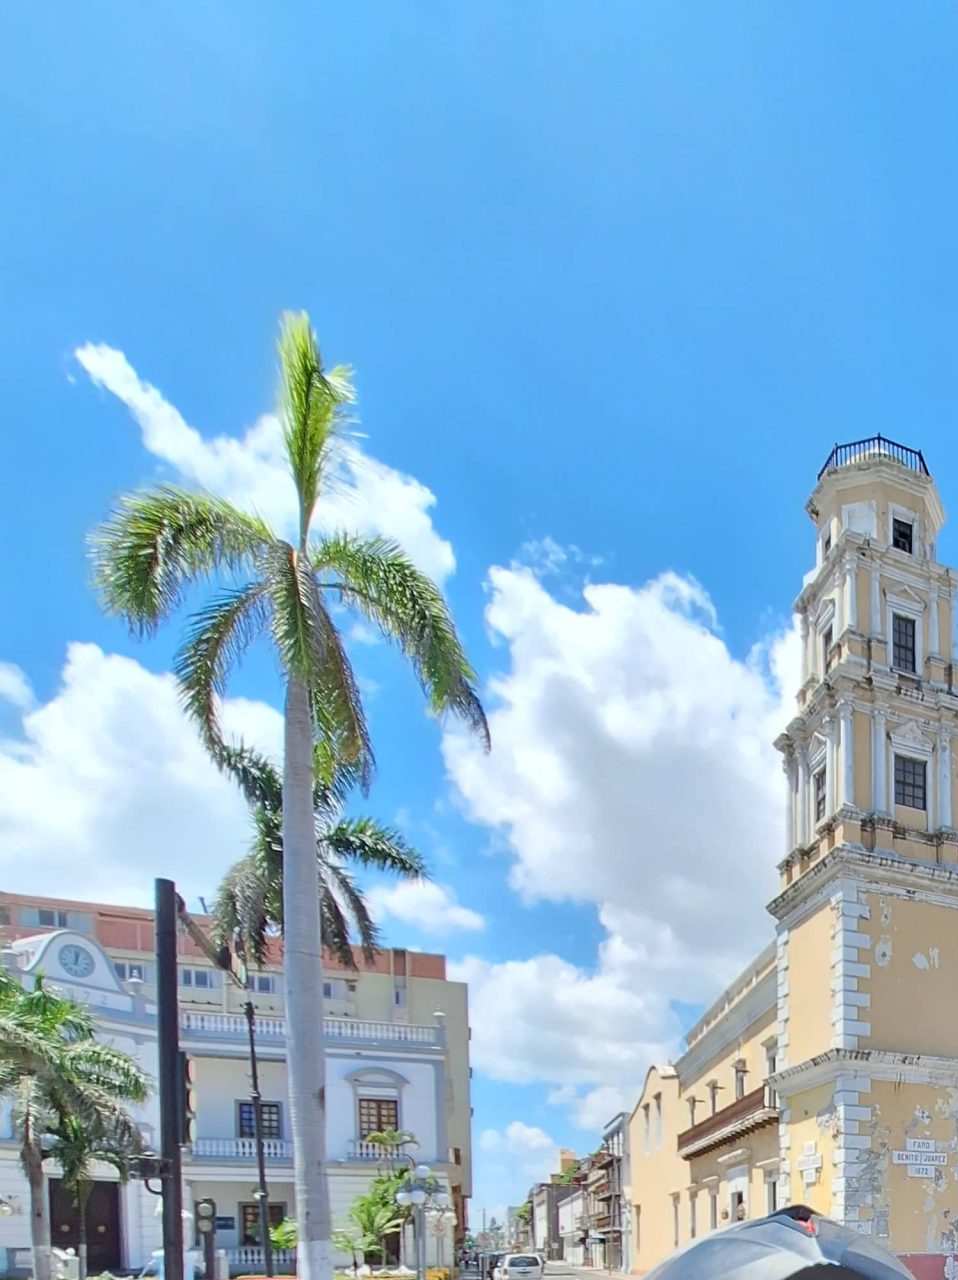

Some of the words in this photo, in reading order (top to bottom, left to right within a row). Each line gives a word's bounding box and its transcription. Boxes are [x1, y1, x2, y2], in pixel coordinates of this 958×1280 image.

[912, 1141, 930, 1149] FARO
[897, 1153, 919, 1161] BENITO
[923, 1155, 946, 1163] JUAREZ
